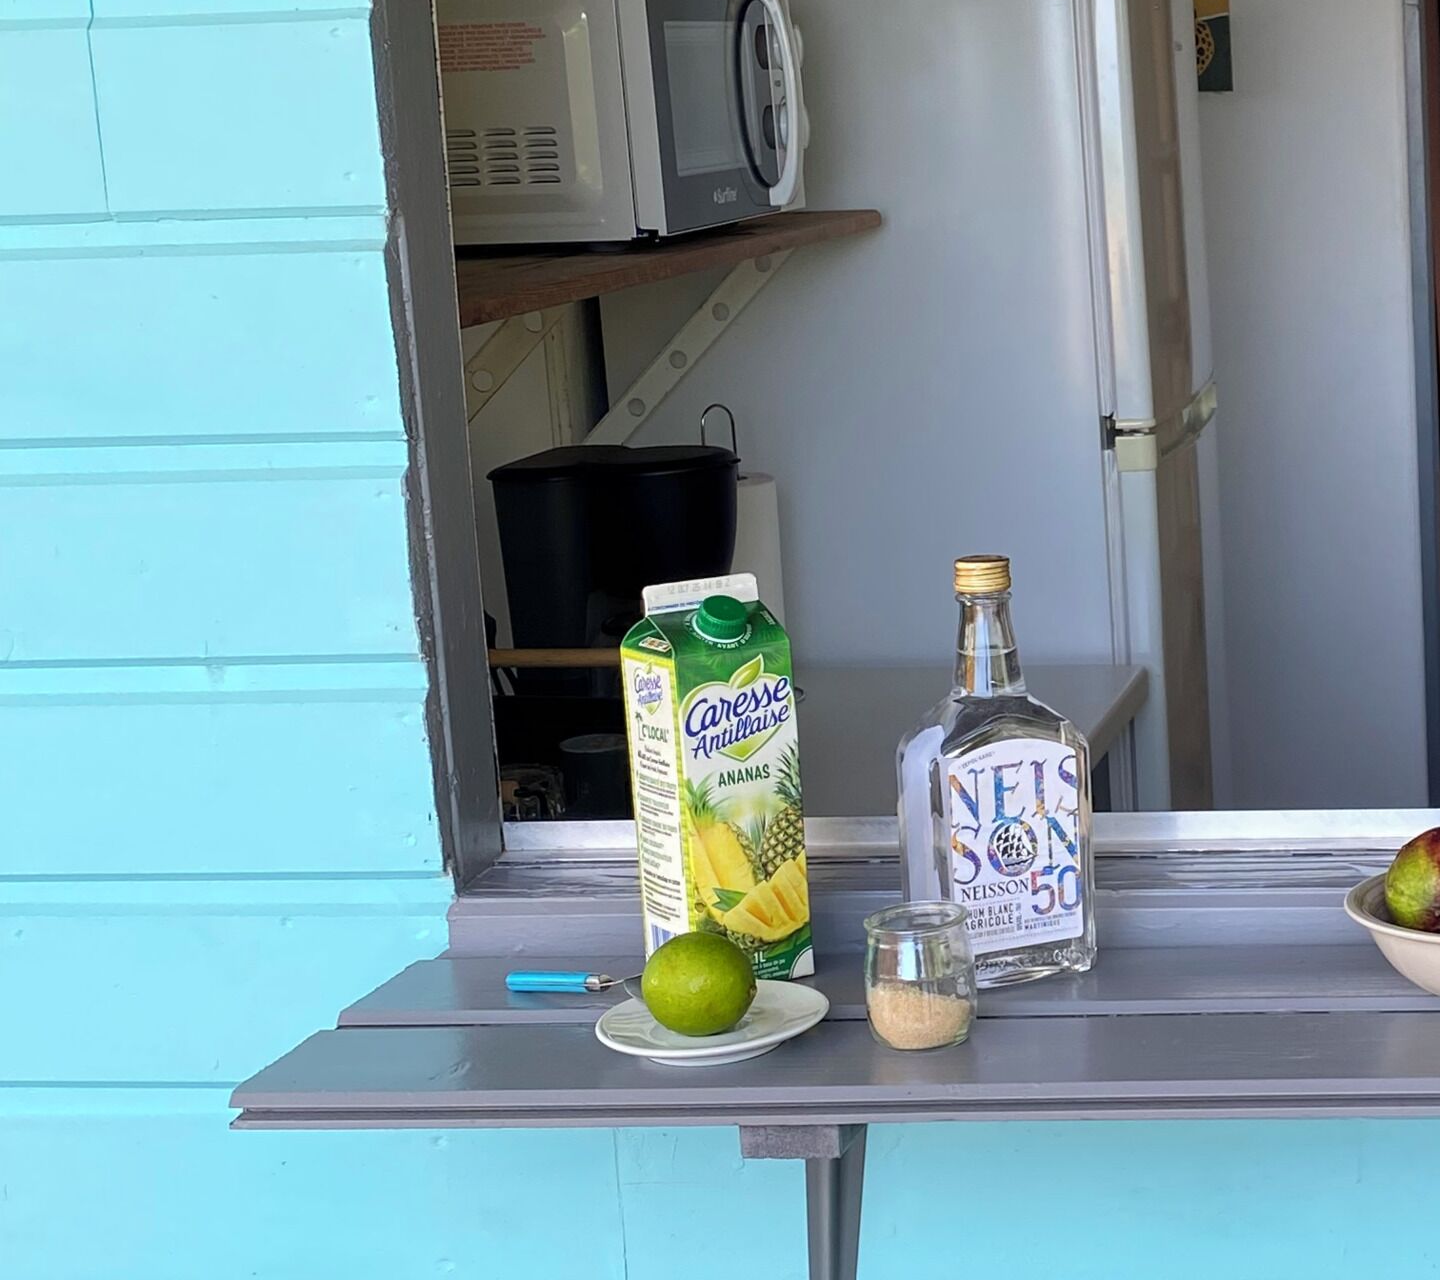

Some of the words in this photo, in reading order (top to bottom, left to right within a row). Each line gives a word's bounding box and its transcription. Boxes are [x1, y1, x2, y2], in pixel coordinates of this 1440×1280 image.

[685, 677, 791, 738] Caresse
[691, 705, 791, 760] Antillaise
[718, 763, 771, 788] ANANAS
[951, 816, 1081, 884] SON
[961, 877, 1029, 903] NEISSON
[966, 906, 985, 921] HUM
[988, 903, 1014, 918] BLANC
[1031, 865, 1081, 915] 50
